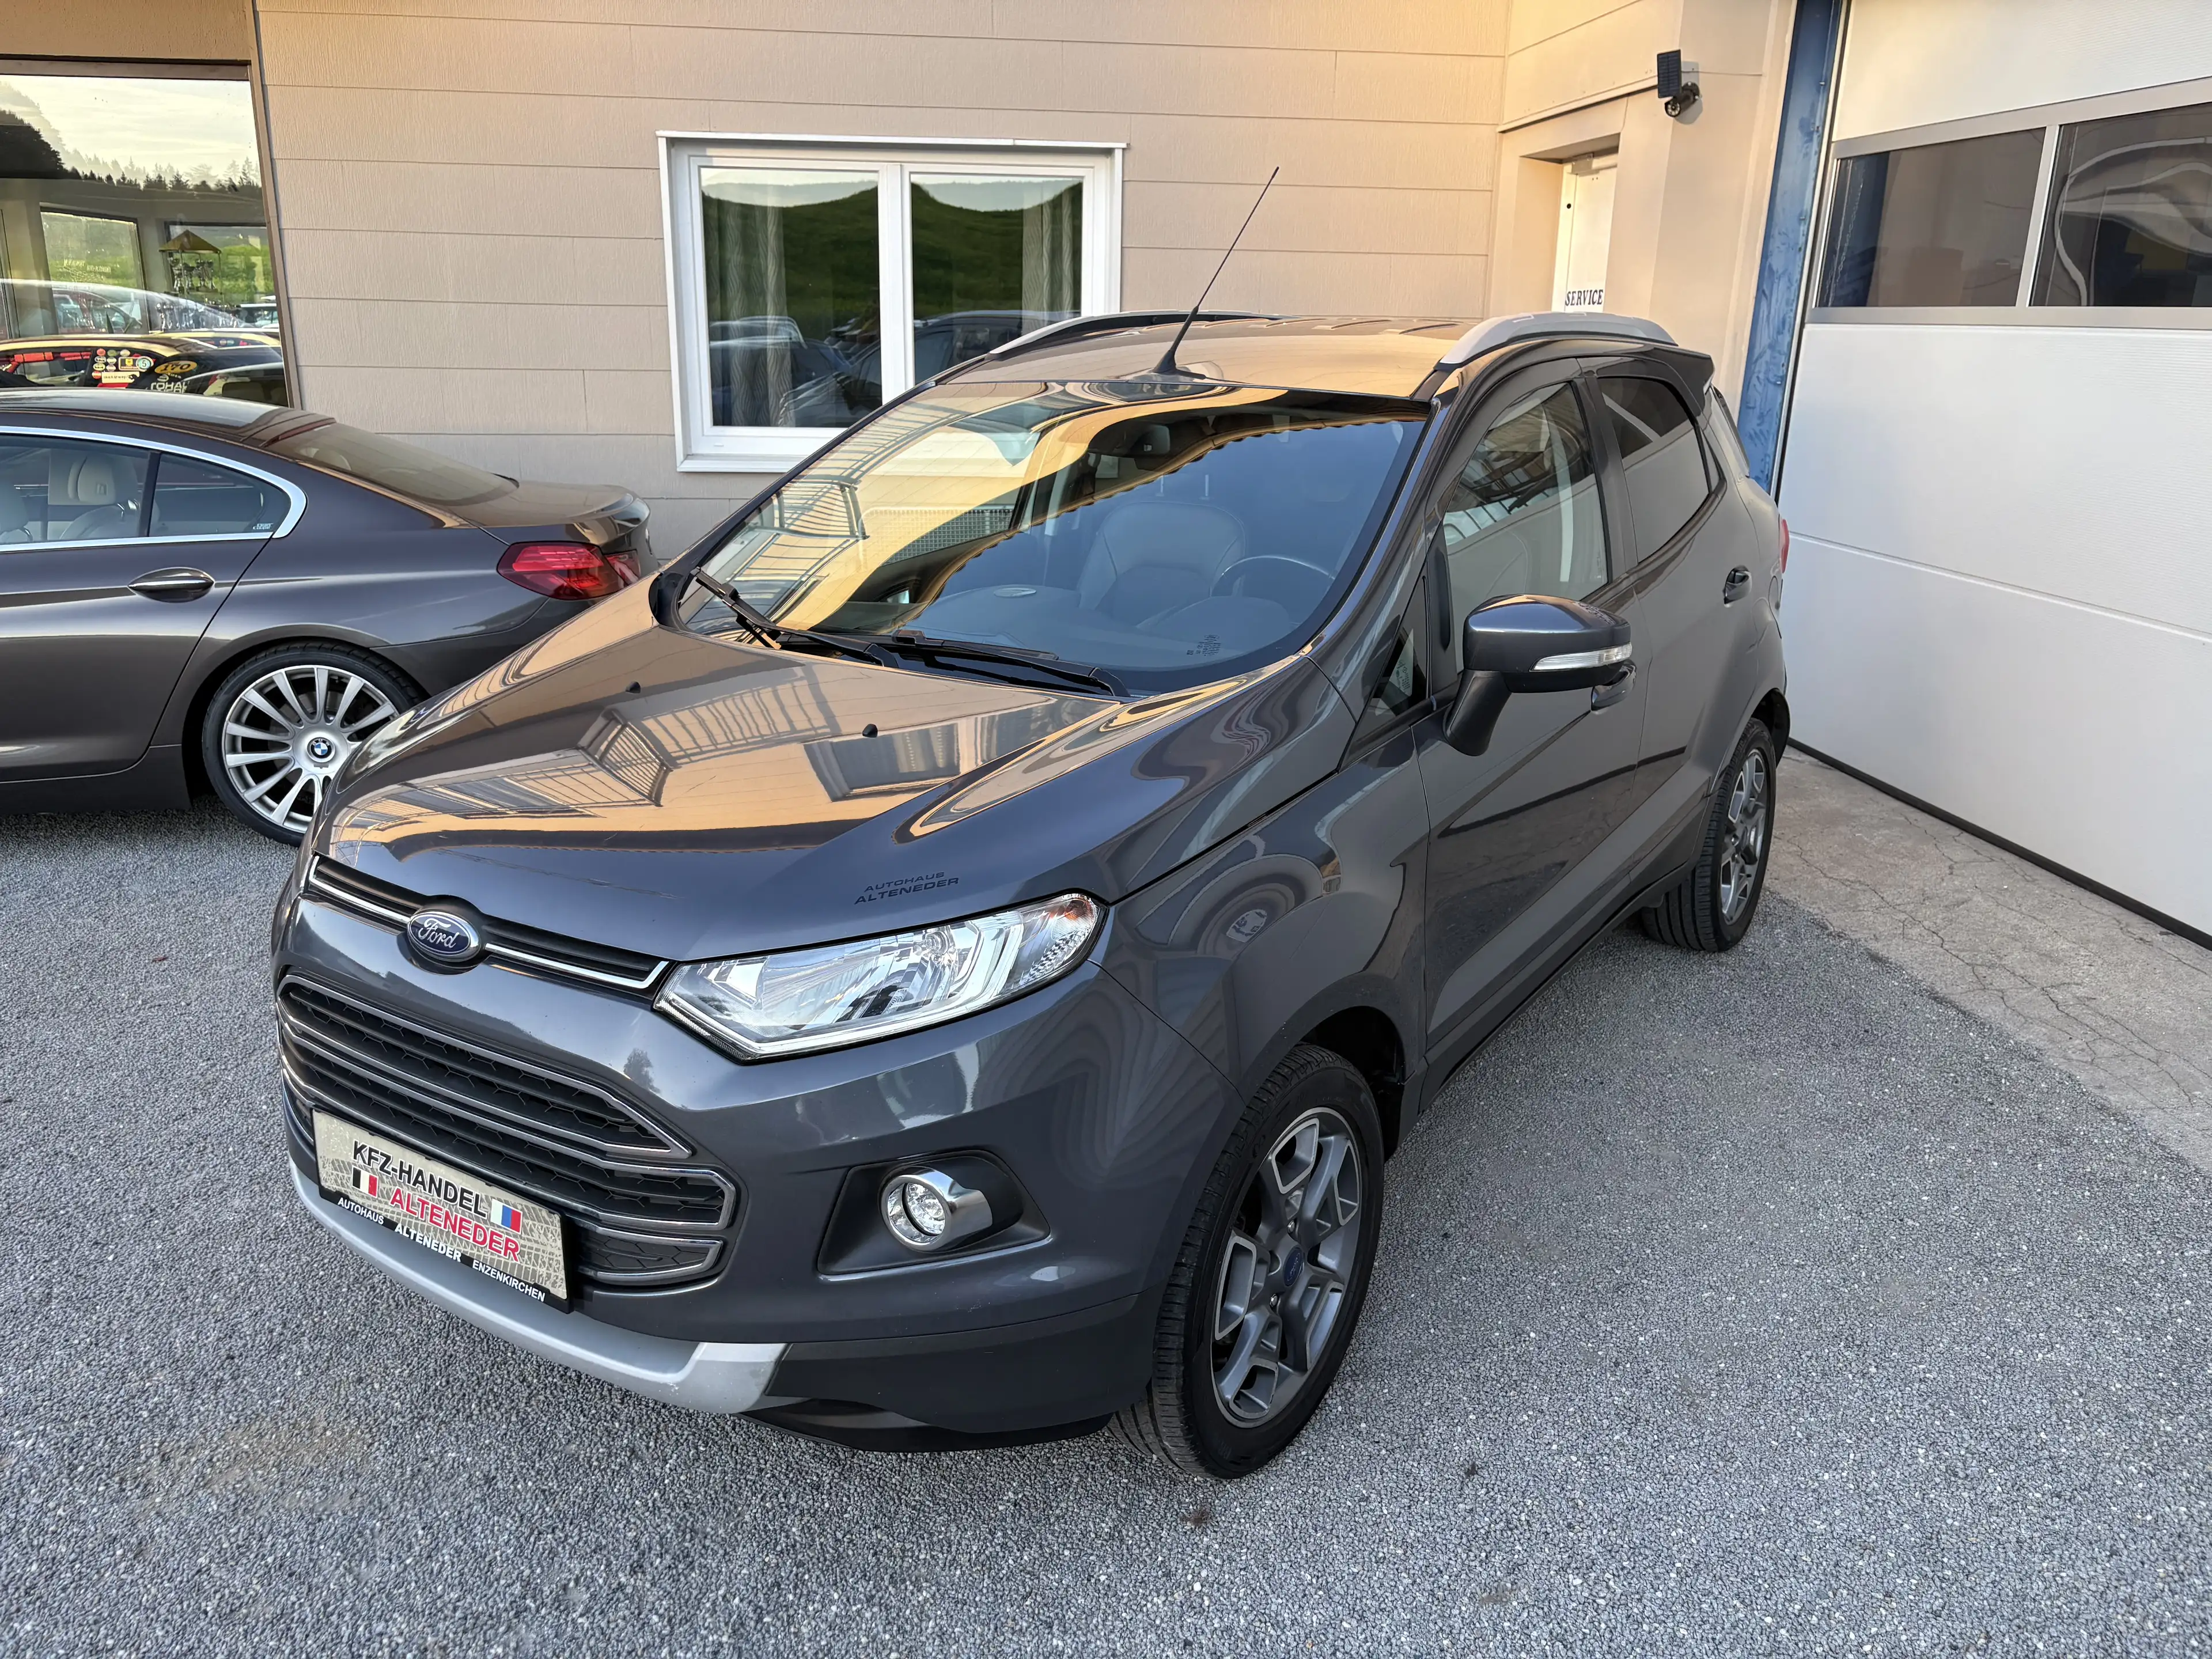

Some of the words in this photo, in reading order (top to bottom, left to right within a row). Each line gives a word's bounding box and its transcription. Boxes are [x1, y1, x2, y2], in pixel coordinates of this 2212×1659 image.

[1565, 289, 1604, 306] SERVICE
[854, 877, 959, 904] ALTENEDER
[864, 872, 945, 892] AUTOHAUS
[418, 918, 460, 948] Ford
[353, 1139, 487, 1219] KFZ-HANDEL
[390, 1187, 520, 1263] ALTENEDER
[338, 1198, 384, 1225] AUTOHAUS
[394, 1223, 462, 1262] ALTENEDER
[472, 1259, 546, 1302] ENZENKIRCHEN
